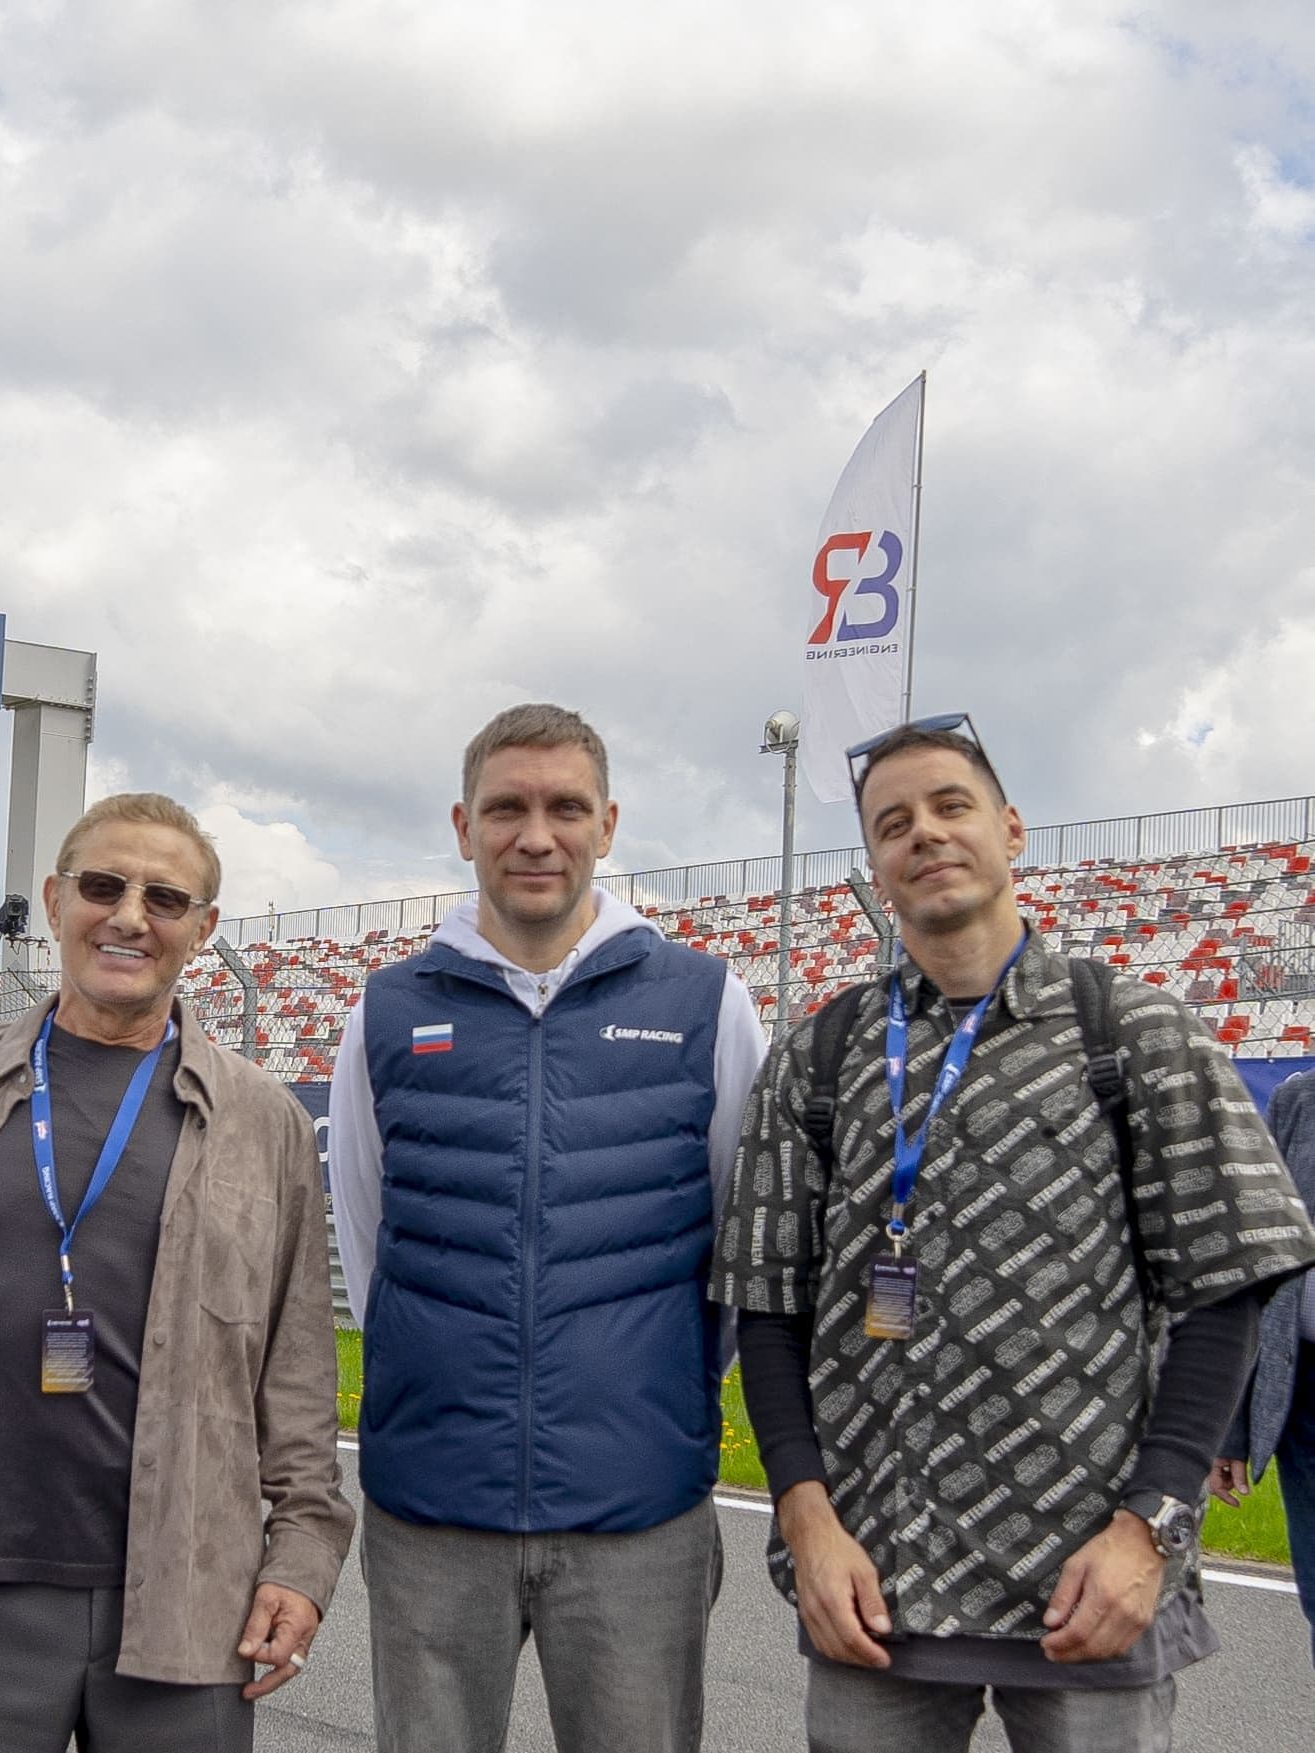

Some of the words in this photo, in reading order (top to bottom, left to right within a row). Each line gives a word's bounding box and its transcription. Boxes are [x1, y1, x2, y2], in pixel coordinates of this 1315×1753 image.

[614, 1028, 640, 1039] SMP
[640, 1029, 684, 1044] RACING
[972, 1022, 1033, 1057] VETEMENTS
[1013, 1062, 1074, 1100] VETEMENTS
[981, 1117, 1037, 1164] VETEMENTS
[780, 1140, 793, 1201] VETEMENTS
[1026, 1166, 1082, 1211] VETEMENTS
[1219, 1162, 1283, 1178] VETEMENTS
[951, 1182, 1007, 1229] VETEMENTS
[1172, 1200, 1228, 1227] VETEMENTS
[751, 1206, 768, 1267] VETEMENTS
[995, 1233, 1054, 1278] VETEMENTS
[1237, 1225, 1302, 1245] VETEMENTS
[964, 1298, 1023, 1344] VETEMENTS
[1039, 1283, 1092, 1328] VETEMENTS
[1012, 1349, 1068, 1397] VETEMENTS
[1083, 1329, 1127, 1376] VETEMENTS
[938, 1365, 992, 1412] VETEMENTS
[836, 1402, 875, 1449] VETEMENTS
[983, 1417, 1041, 1464] VETEMENTS
[1060, 1396, 1106, 1445] VETEMENTS
[956, 1484, 1012, 1530] VETEMENTS
[1033, 1464, 1088, 1513] VETEMENTS
[931, 1550, 985, 1594] VETEMENTS
[1006, 1532, 1062, 1581] VETEMENTS
